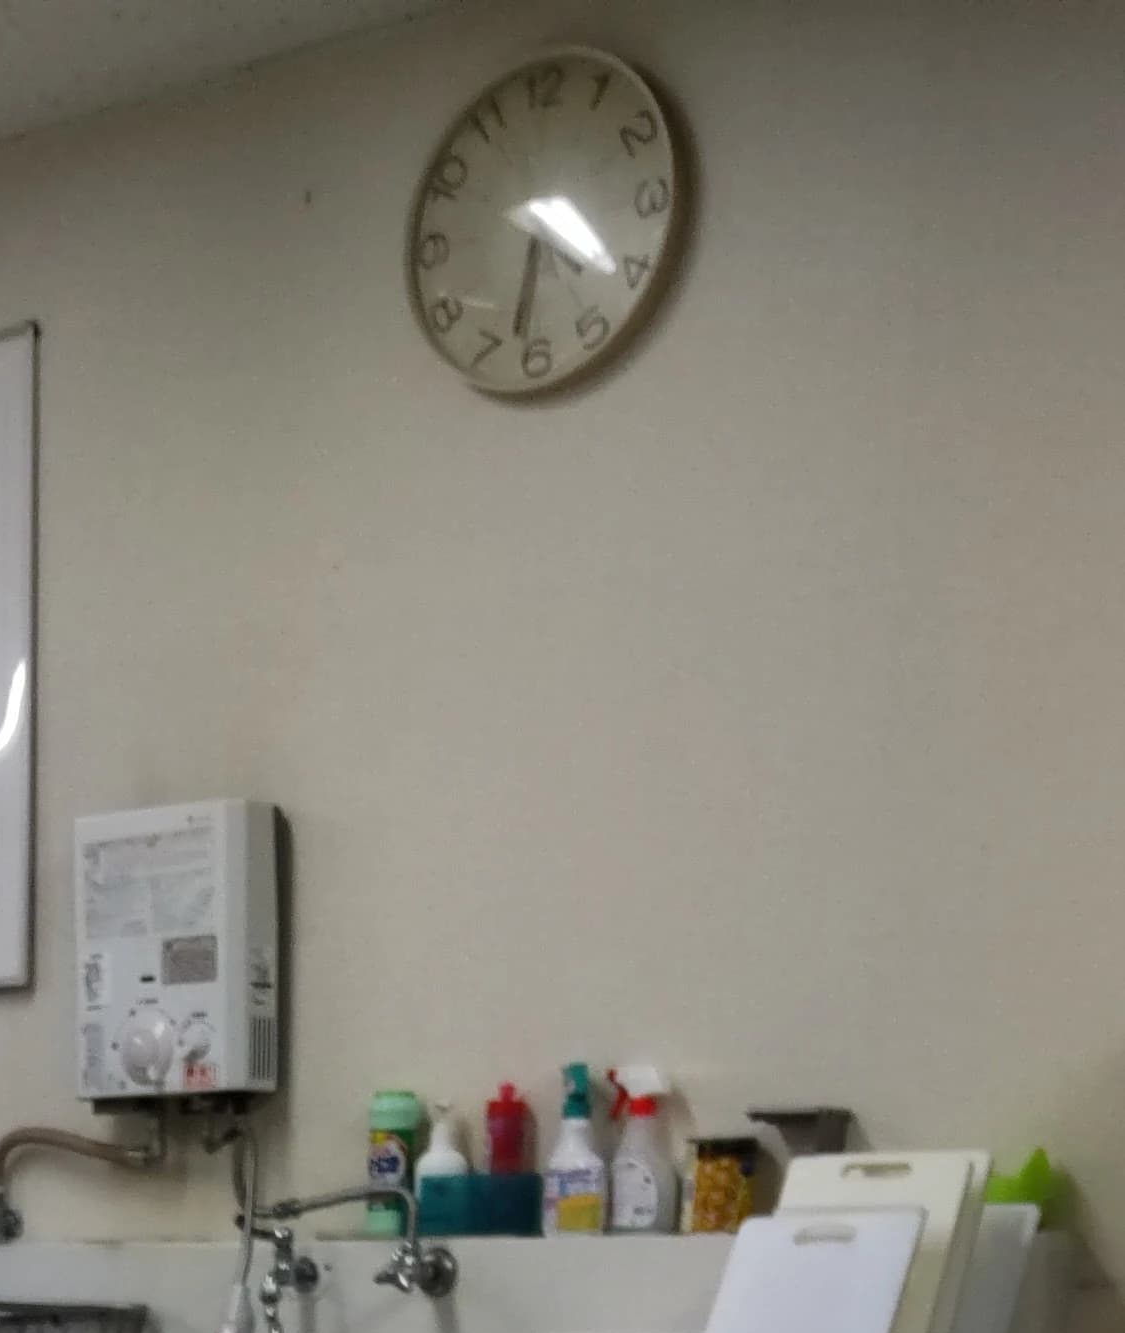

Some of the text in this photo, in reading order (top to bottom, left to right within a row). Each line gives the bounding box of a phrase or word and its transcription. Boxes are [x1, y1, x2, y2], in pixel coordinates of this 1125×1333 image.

[526, 67, 564, 108] 12
[590, 75, 610, 111] 1
[465, 96, 507, 144] 11
[619, 110, 658, 158] 2
[428, 155, 468, 200] 10
[635, 177, 669, 219] 3
[420, 232, 450, 270] 9
[624, 254, 651, 289] 4
[431, 296, 463, 334] 8
[576, 306, 610, 351] 5
[471, 329, 503, 370] 7
[522, 338, 552, 378] 6
